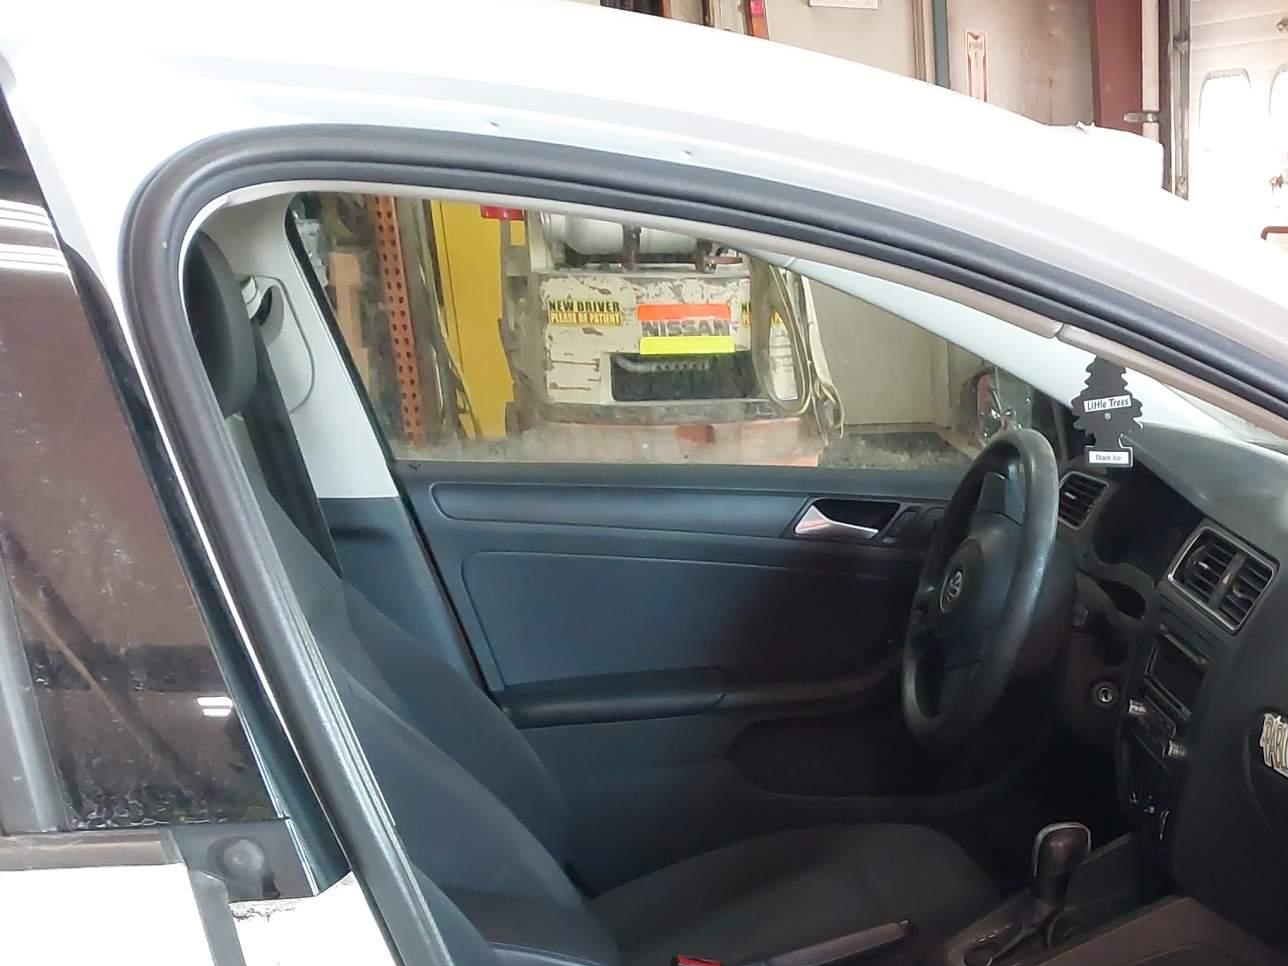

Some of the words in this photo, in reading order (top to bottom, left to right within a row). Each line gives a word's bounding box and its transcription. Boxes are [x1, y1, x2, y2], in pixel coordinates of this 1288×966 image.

[549, 301, 574, 312] NEW
[577, 301, 621, 313] DRIVER
[590, 313, 621, 325] PATIENT
[641, 319, 730, 336] NISSAN
[1087, 400, 1107, 411] Little
[1109, 398, 1129, 408] Trees
